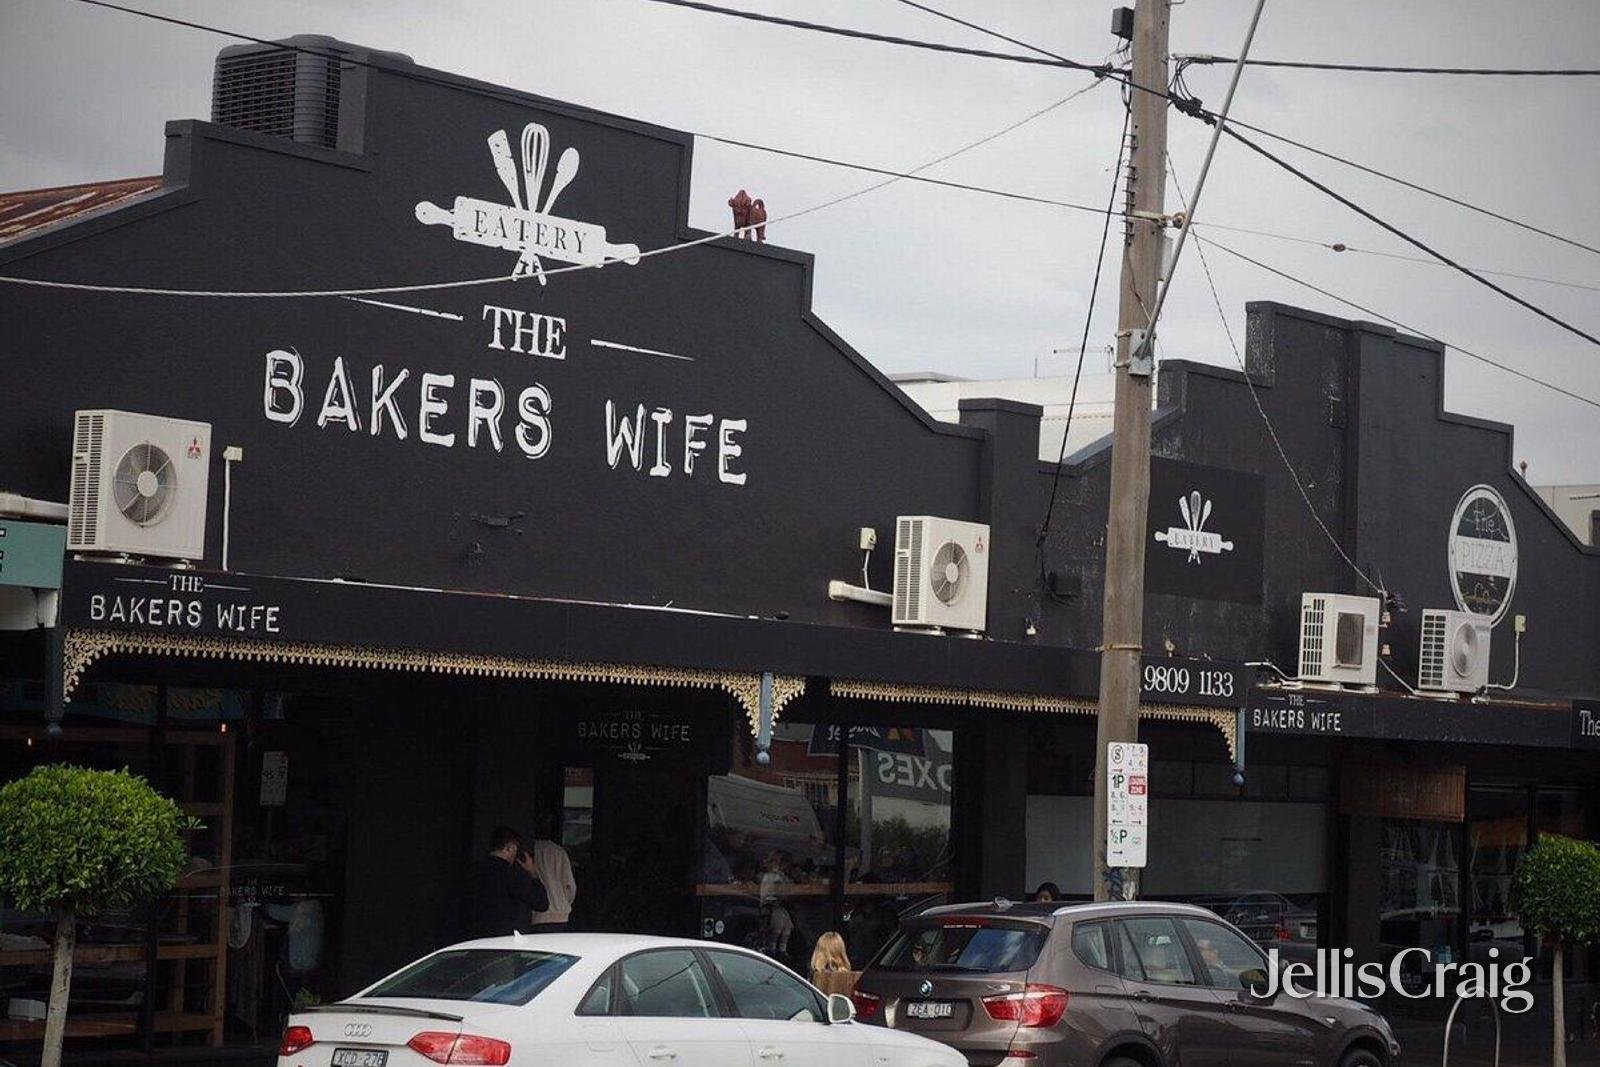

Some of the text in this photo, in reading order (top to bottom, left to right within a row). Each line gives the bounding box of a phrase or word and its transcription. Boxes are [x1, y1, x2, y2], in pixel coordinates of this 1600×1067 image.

[473, 209, 590, 256] EATERY
[482, 304, 568, 360] THE
[264, 347, 748, 486] BAKERS WIFE
[169, 573, 205, 594] THE
[89, 594, 282, 634] BAKERS WIFE
[1144, 664, 1235, 698] 9809 1133
[577, 721, 691, 742] BAKERS WIFE
[1253, 708, 1342, 732] BAKERS WIFE
[1578, 709, 1600, 737] The
